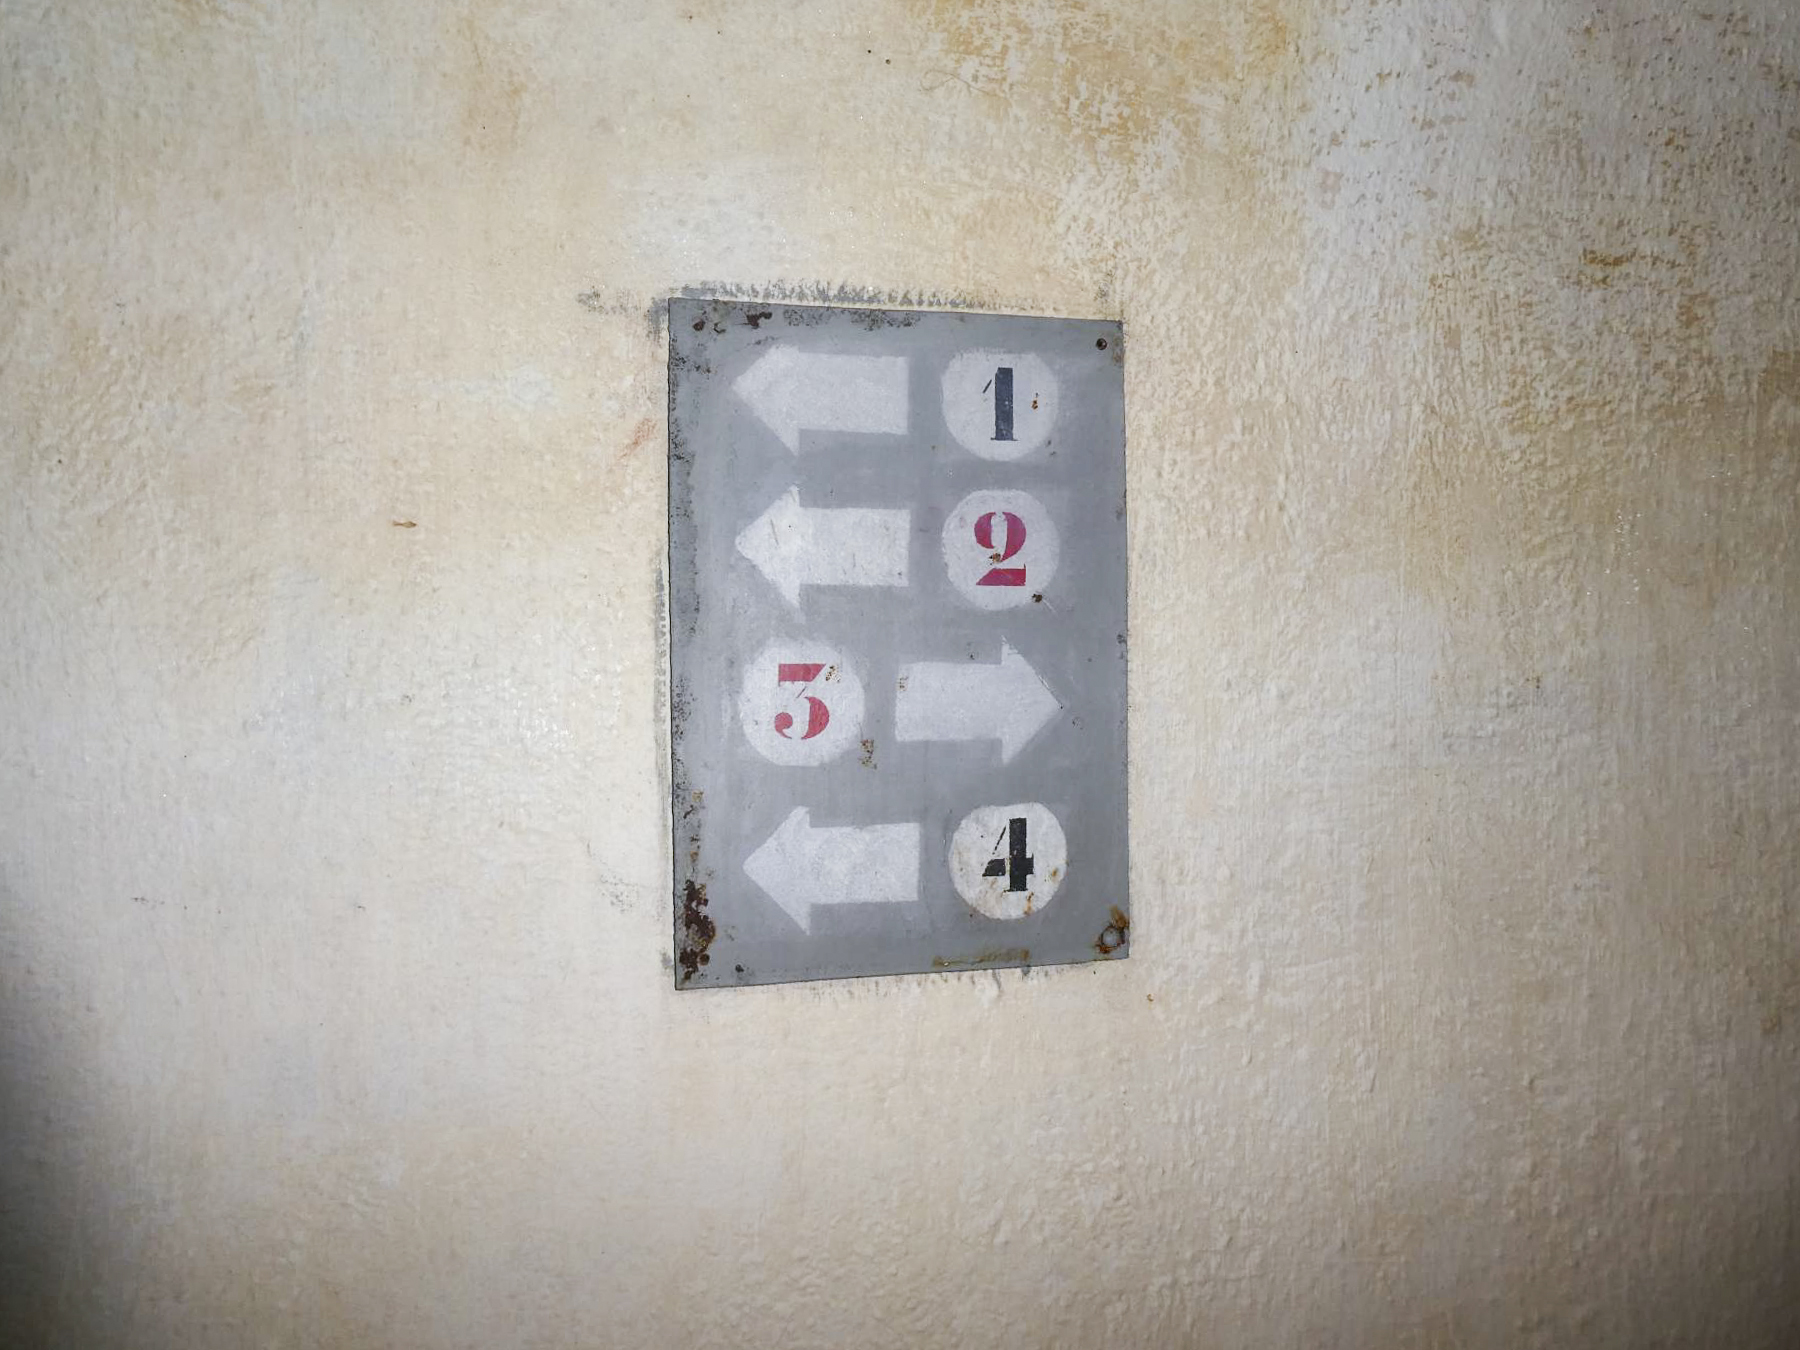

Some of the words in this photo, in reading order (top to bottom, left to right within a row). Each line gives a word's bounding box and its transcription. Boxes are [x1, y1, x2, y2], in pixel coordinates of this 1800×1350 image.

[982, 367, 1020, 441] 1
[974, 511, 1026, 586] 2
[774, 663, 830, 740] 3
[982, 818, 1034, 892] 4
